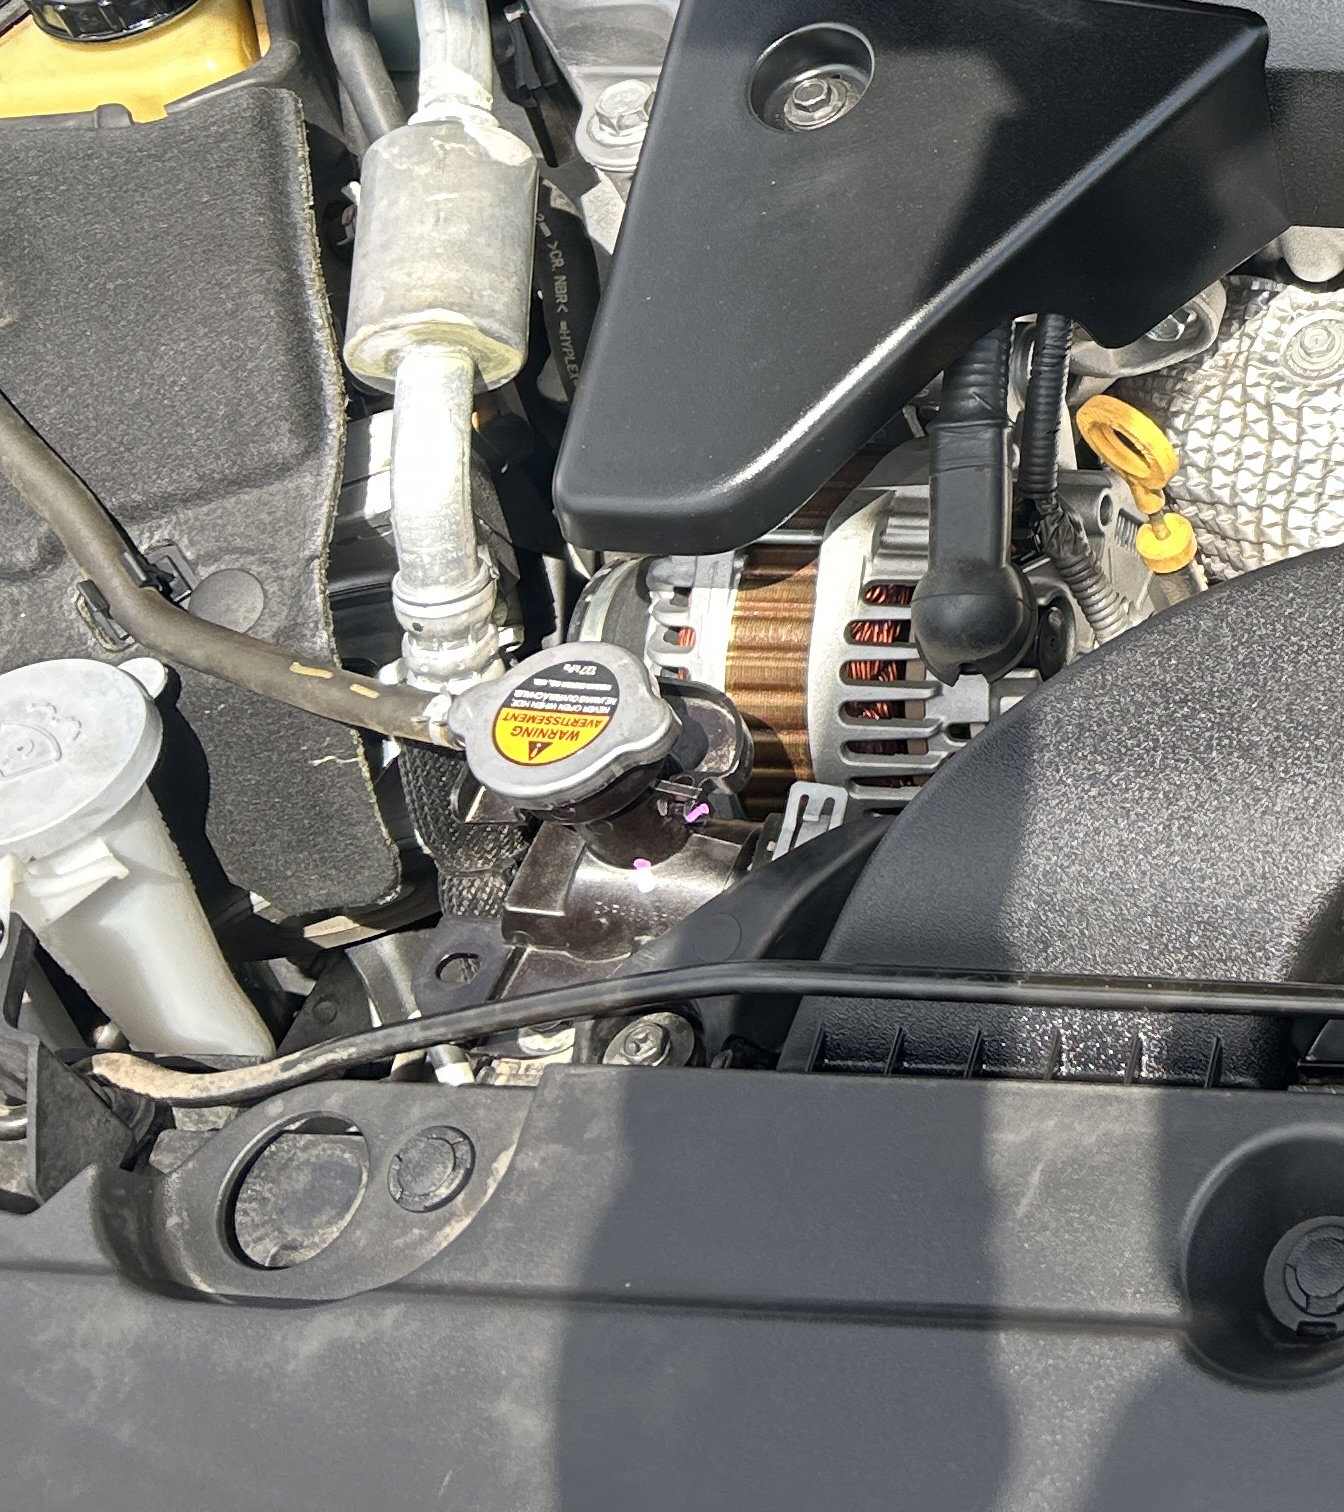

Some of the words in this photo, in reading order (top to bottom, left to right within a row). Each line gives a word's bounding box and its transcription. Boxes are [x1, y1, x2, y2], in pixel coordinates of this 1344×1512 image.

[582, 705, 611, 714] NEVER
[502, 711, 603, 729] AVERTISSEMENT
[510, 725, 580, 742] WARNING
